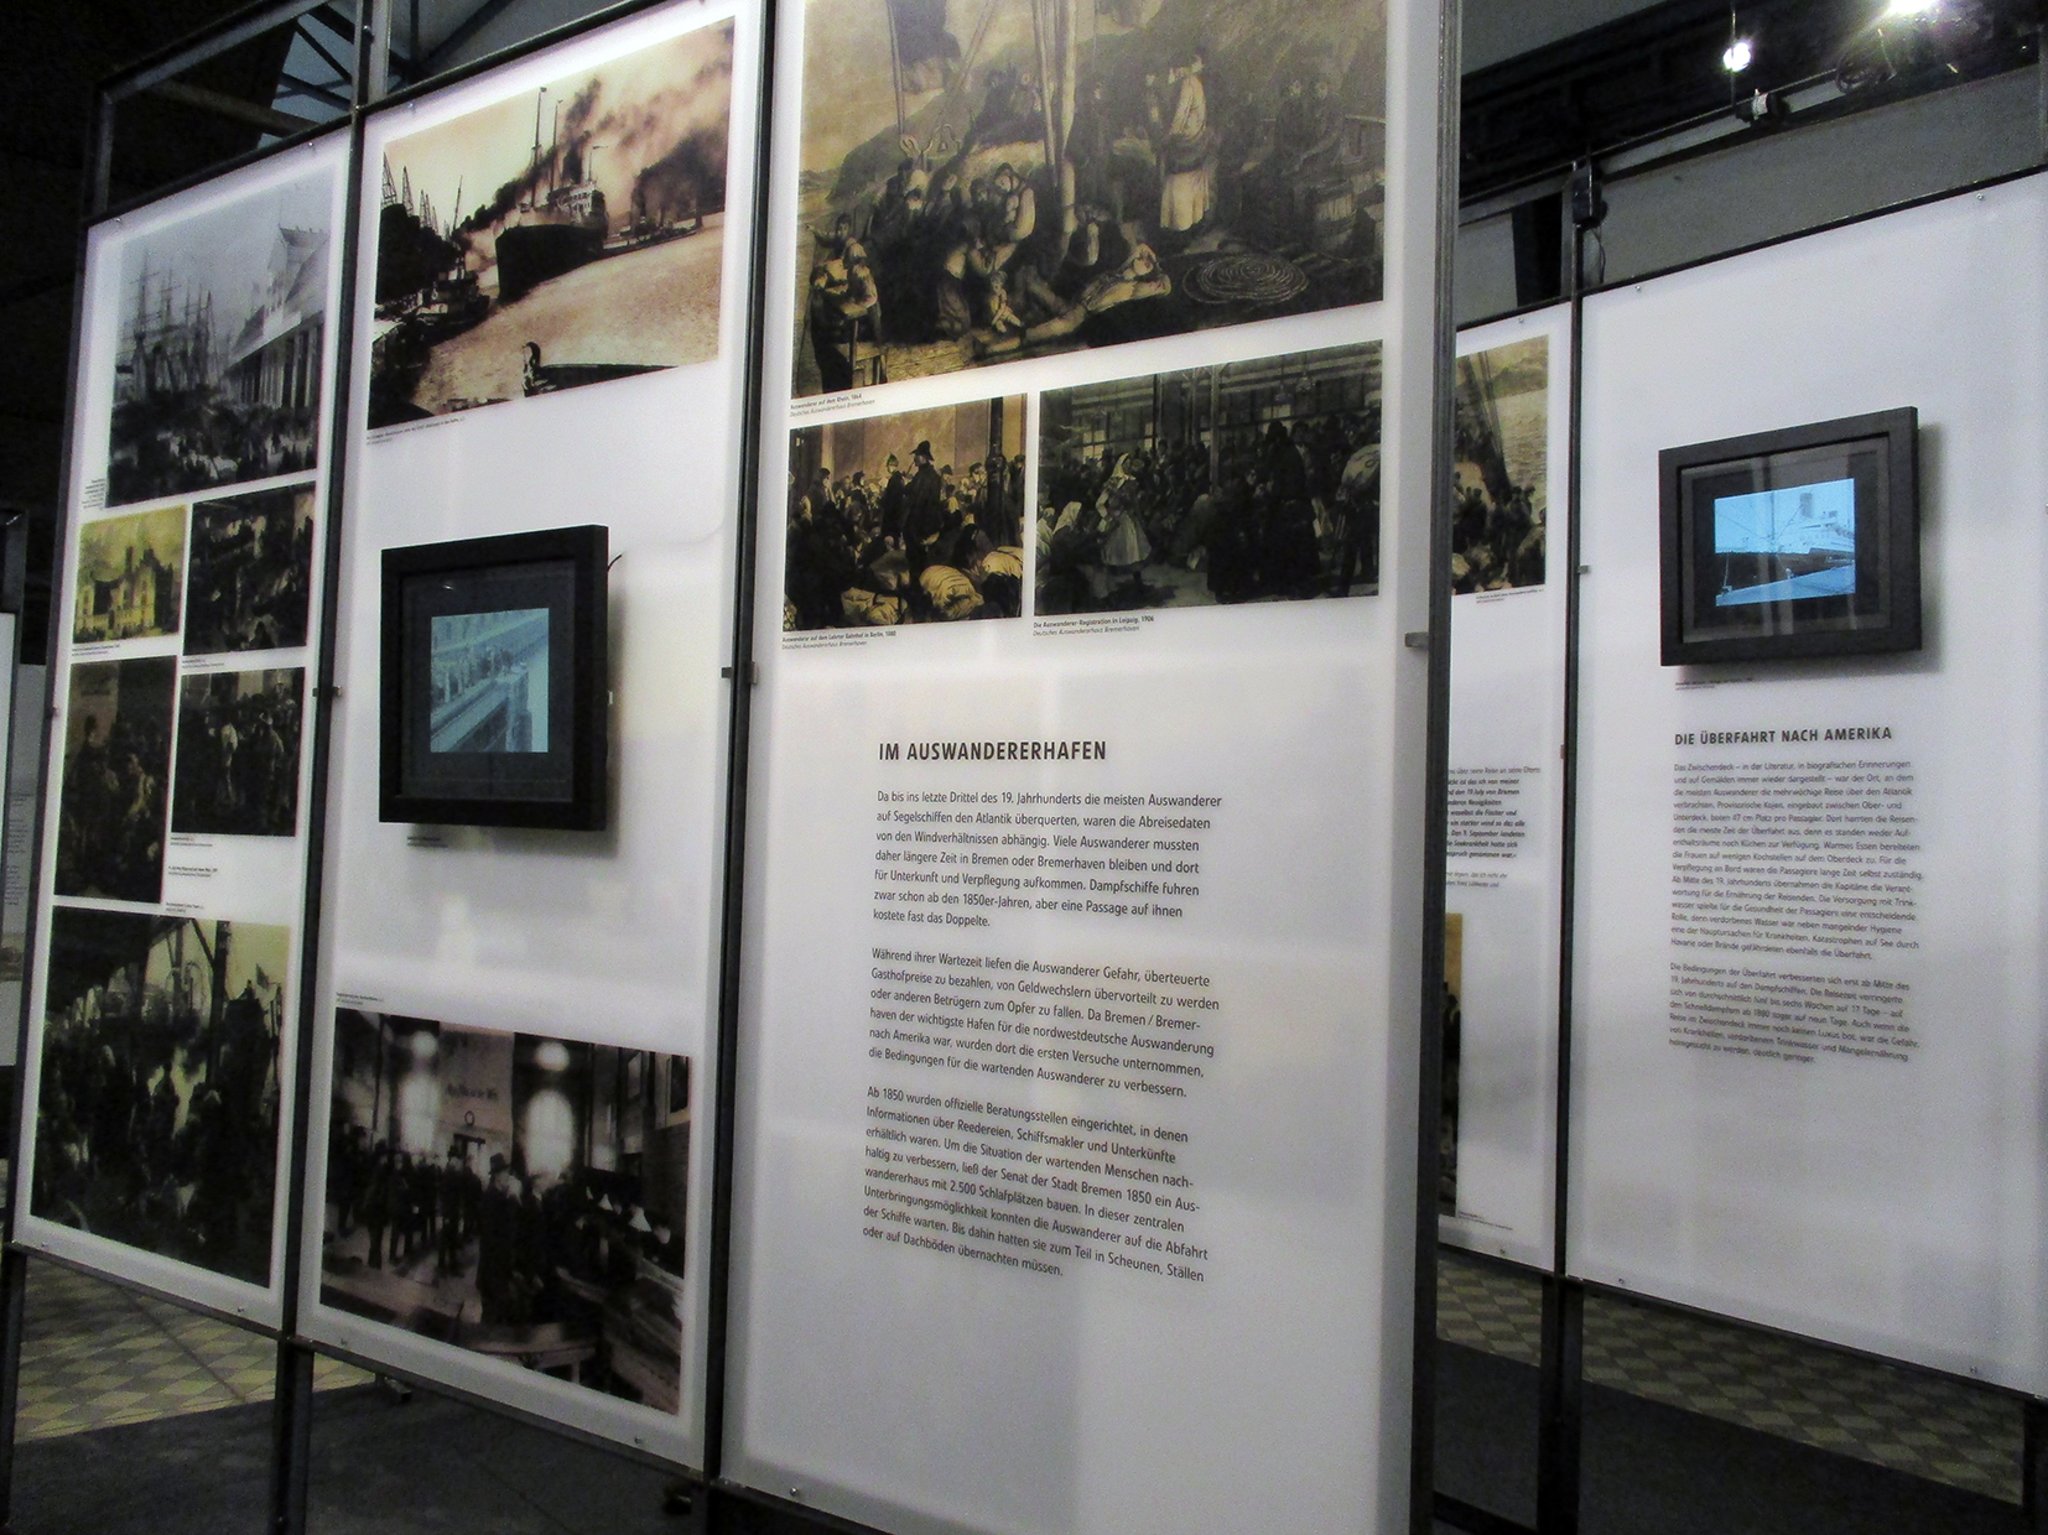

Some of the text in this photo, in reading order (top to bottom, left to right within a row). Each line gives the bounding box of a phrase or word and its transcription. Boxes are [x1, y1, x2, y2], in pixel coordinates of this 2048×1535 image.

[1674, 726, 1892, 745] DIE ÜBERFAHRT NACH AMERIKA
[878, 741, 1106, 760] IM AUSWANDERERHAFEN
[877, 790, 1222, 807] Da bis ins letzte Drittel des 19. Jahrhunderts die meisten Auswanderer
[876, 810, 1210, 829] auf Segelschiffen den Atlantik überquerten, waren die Abreisedaten
[876, 831, 1199, 851] von den Windverhältnissen abhängig. Viele Auswanderer mussten
[875, 849, 1199, 874] daher längere Zeit in Bremen oder Bremerhaven bleiben und dort
[874, 868, 1199, 896] für Unterkunft und Verpflegung aufkommen. Dampfschiffe fuhren
[873, 890, 1183, 917] zwar schon ab den 1850er-Jahren, aber eine Passage auf ihnen
[873, 908, 990, 927] kostete fast das Doppelte.
[872, 947, 1210, 987] Während ihrer Wartezeit liefen die Auswanderer Gefahr, überteuerte
[871, 967, 1219, 1010] Gasthofpreise zu bezahlen, von Geldwechslern übervorteilt zu werden
[870, 1007, 1214, 1057] haven der wichtigste Hafen für die nordwestdeutsche Auswanderung
[868, 1047, 1186, 1097] die Bedingungen für die wartenden Auswanderer zu verbessern.
[867, 1086, 1188, 1142] Ab 1850 wurden offizielle Beratungsstellen eingerichtet, in denen
[866, 1106, 1175, 1163] Informationen über Reedereien, Schiffsmakler und Unterkünfte
[865, 1168, 1184, 1232] wandererhaus mit 2.500 Schlafplätzen bauen. In dieser zentralen
